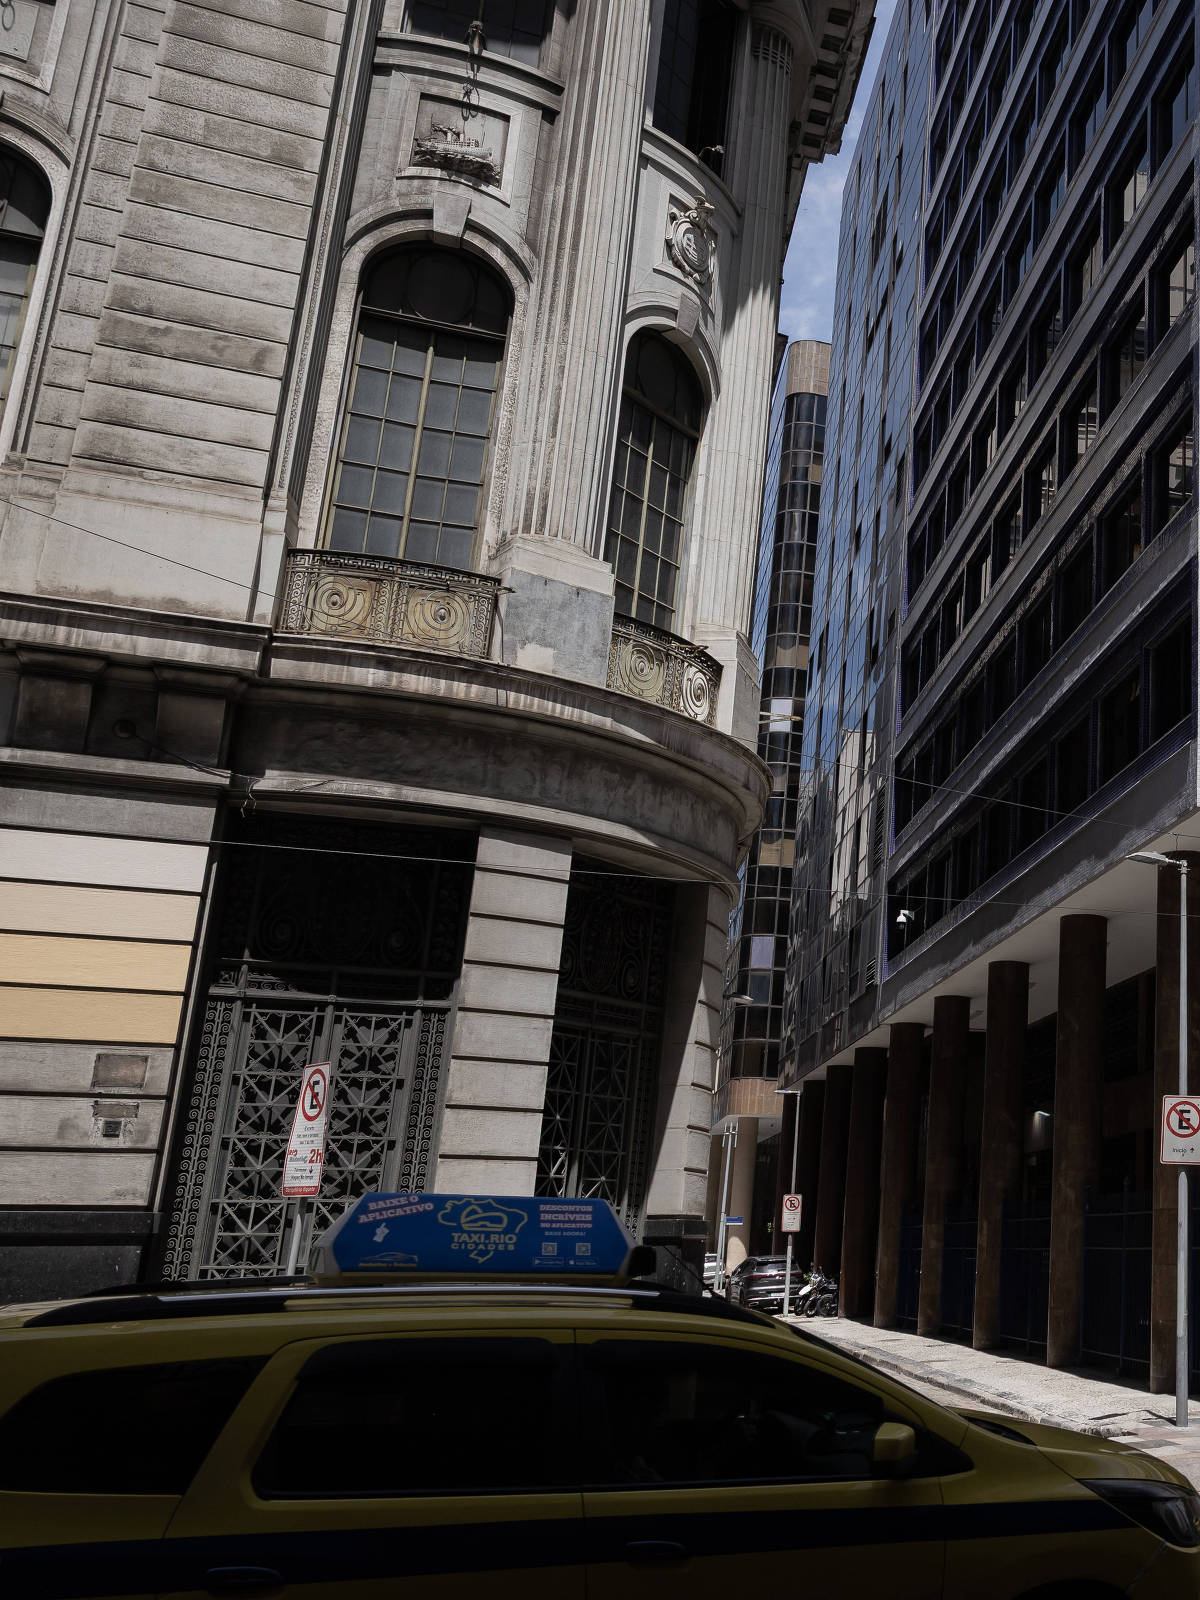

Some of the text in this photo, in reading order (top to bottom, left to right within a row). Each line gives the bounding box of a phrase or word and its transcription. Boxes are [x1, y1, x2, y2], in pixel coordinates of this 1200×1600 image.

[308, 1149, 322, 1164] 2h
[367, 1195, 419, 1210] BAIXE O
[358, 1202, 434, 1224] APLICATIVO
[540, 1212, 592, 1221] INCRÍVEIS
[451, 1233, 517, 1244] TAXI.RIO
[450, 1243, 515, 1251] CIDADES
